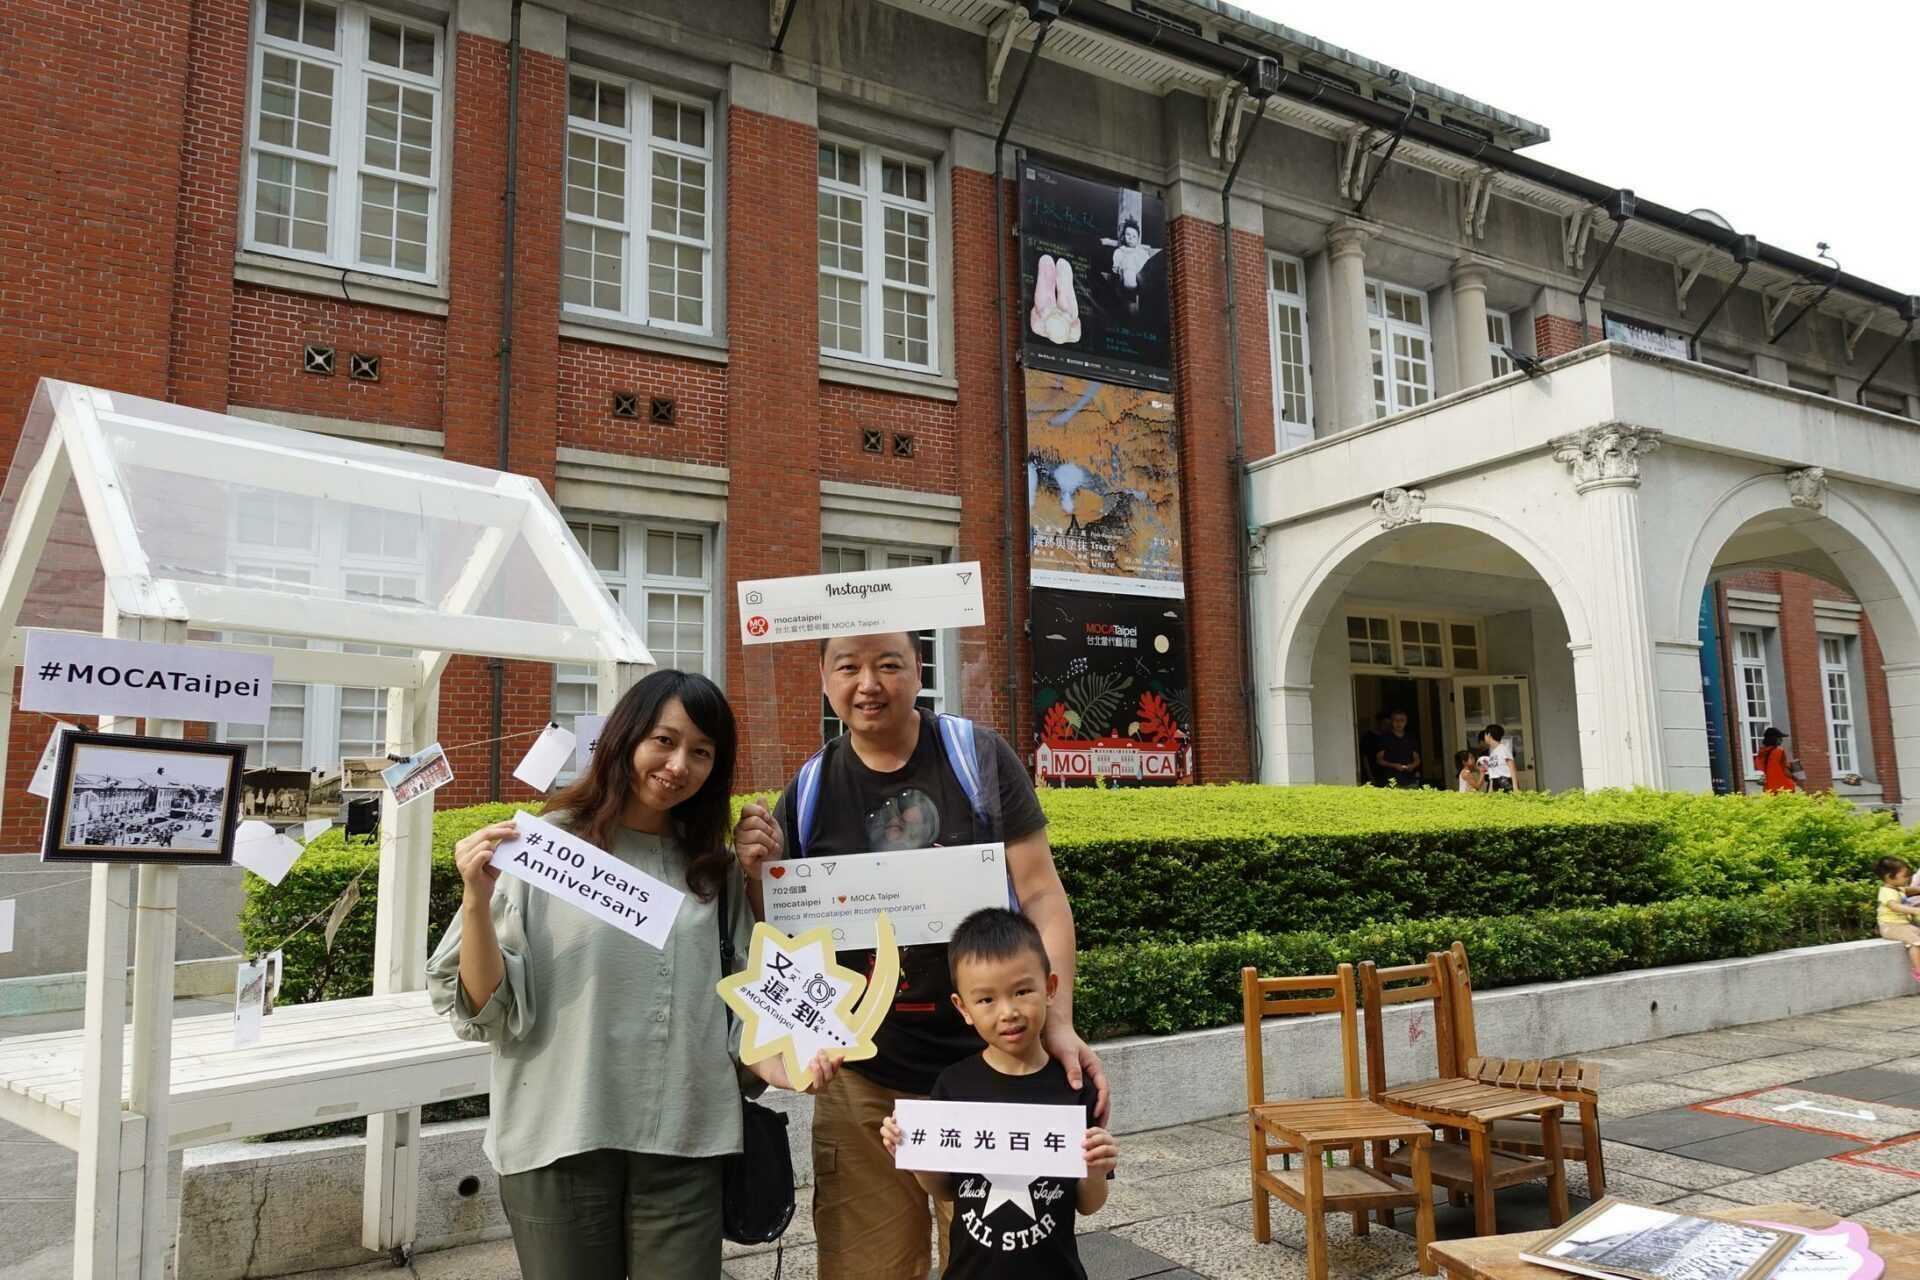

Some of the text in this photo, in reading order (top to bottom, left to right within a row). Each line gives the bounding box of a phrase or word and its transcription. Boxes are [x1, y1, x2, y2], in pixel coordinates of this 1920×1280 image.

[825, 581, 894, 600] Instagram
[774, 613, 822, 625] mocataipei
[832, 620, 856, 630] MOCA
[858, 619, 880, 630] Taipei
[38, 661, 260, 699] #MOCATaipei
[525, 832, 651, 904] #100 years
[513, 850, 649, 928] Anniversary
[773, 897, 821, 909] mocataipei
[850, 893, 875, 902] MOCA
[877, 891, 900, 902] Taipei
[773, 912, 801, 922] #moca
[802, 908, 853, 921] #mocataipei
[740, 985, 795, 1030] #MOCATaipei
[958, 1178, 1065, 1206] Chuck Taylor
[961, 1208, 1057, 1251] ALL STAR
